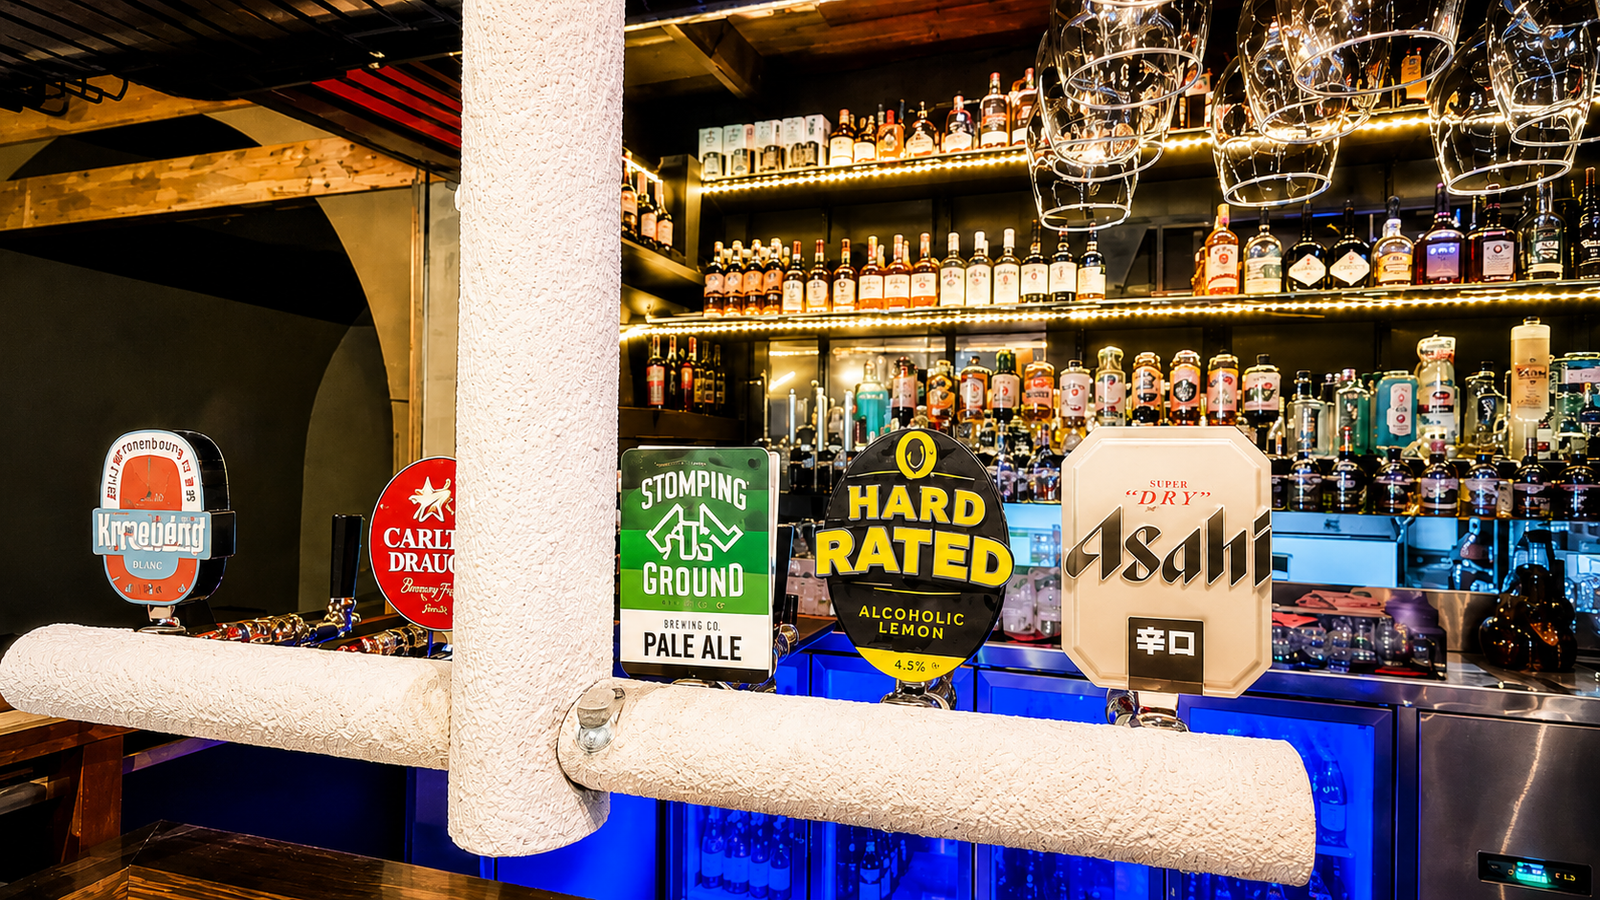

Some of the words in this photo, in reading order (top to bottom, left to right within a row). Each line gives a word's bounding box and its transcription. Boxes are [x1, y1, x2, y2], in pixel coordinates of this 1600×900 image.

[641, 469, 749, 512] STOMPING
[1149, 479, 1189, 489] SUPER
[847, 484, 986, 528] HARD
[814, 526, 1014, 589] RATED
[1064, 504, 1272, 589] Asahi
[643, 560, 744, 598] GROUND
[663, 619, 703, 631] BREWING
[706, 620, 721, 632] CO.
[858, 605, 965, 627] ALCOHOLIC
[878, 621, 945, 640] LEMON
[644, 632, 695, 659] PALE
[701, 635, 742, 662] ALE
[1136, 626, 1195, 657] 辛口
[894, 659, 926, 673] 4.5%
